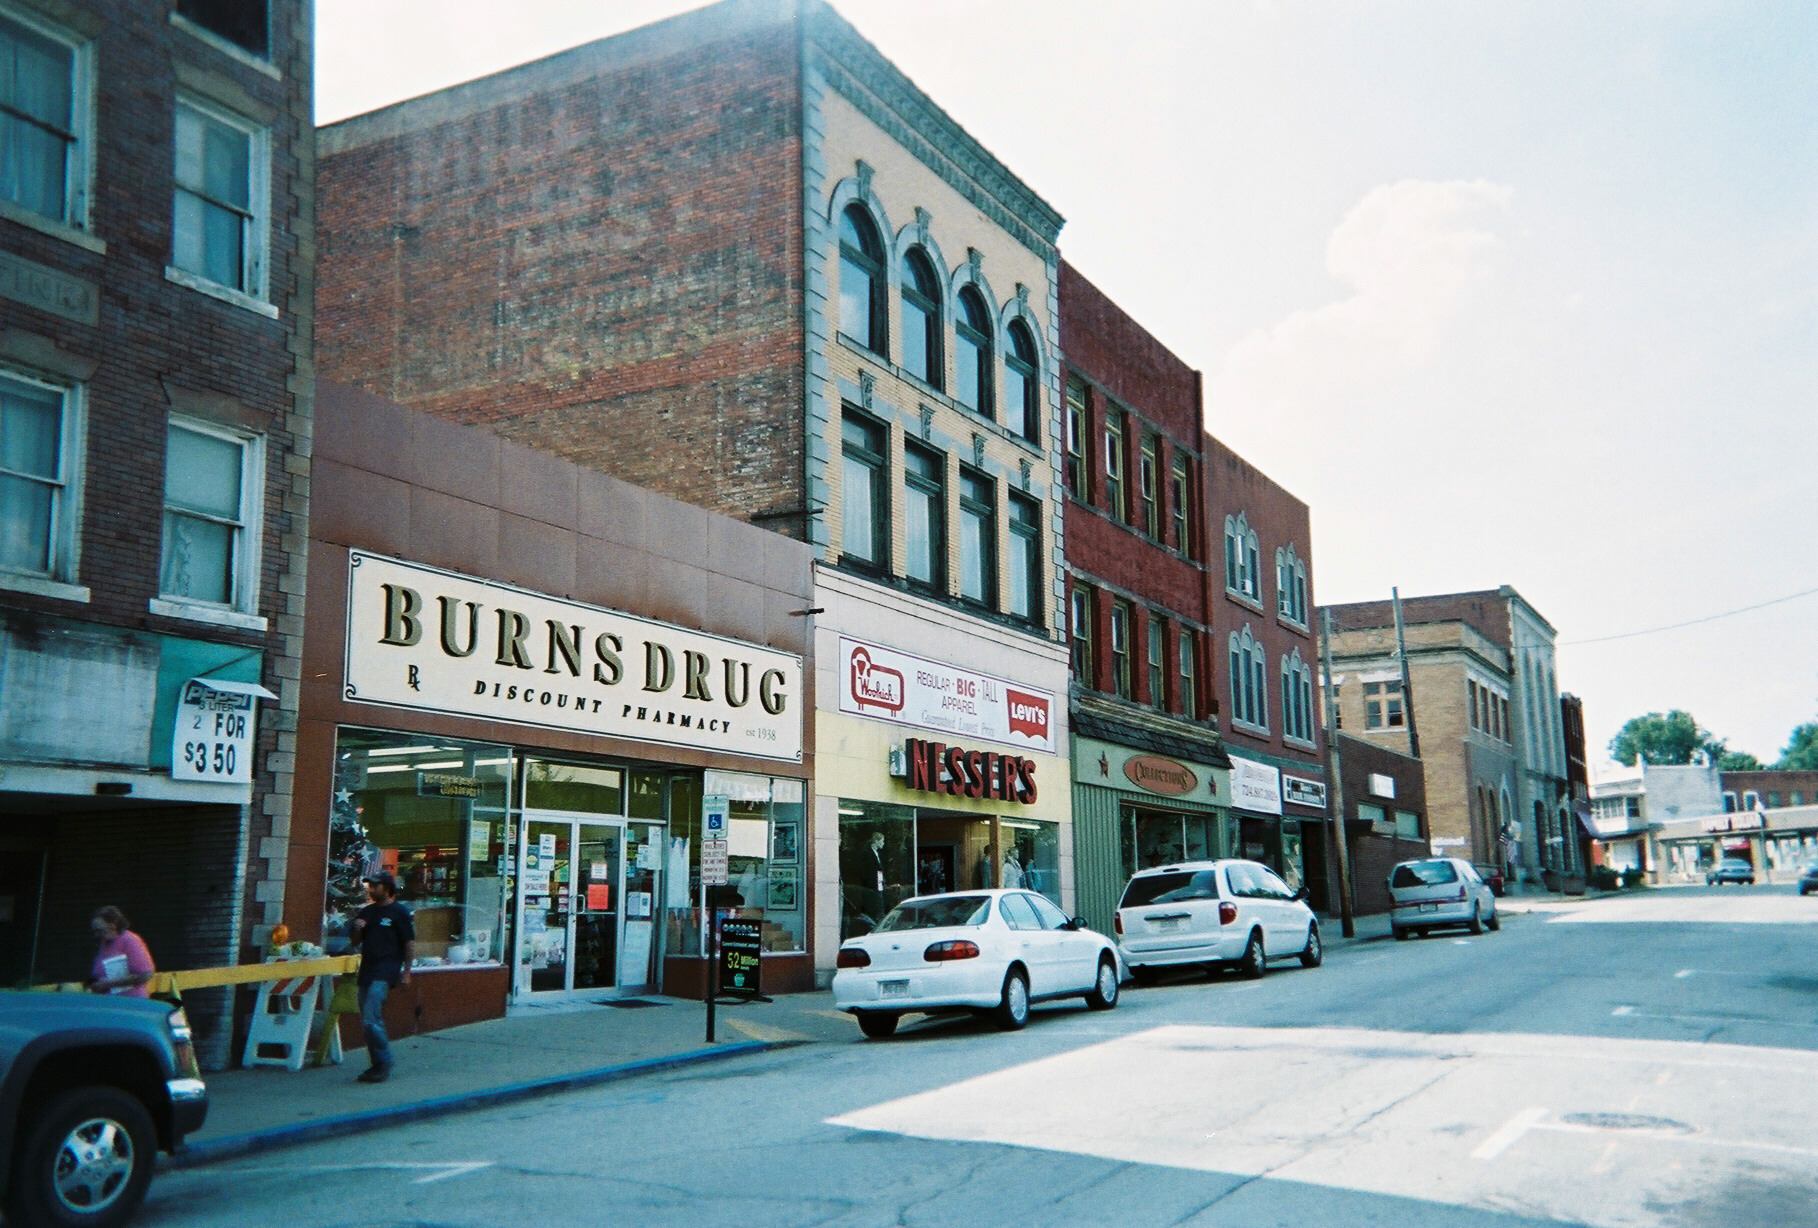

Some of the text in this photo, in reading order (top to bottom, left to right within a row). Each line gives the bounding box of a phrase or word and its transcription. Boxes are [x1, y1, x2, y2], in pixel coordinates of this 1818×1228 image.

[378, 582, 788, 716] BURNS DRUG
[917, 670, 999, 704] REGULAR BIG TALL
[208, 701, 234, 713] LITER
[474, 679, 731, 734] DISCOUNT PHARMACY
[941, 695, 978, 716] APPAREL
[192, 712, 245, 739] 2 FOR
[757, 727, 777, 741] 1938
[905, 737, 1038, 805] NESSER'S
[727, 951, 740, 969] 52
